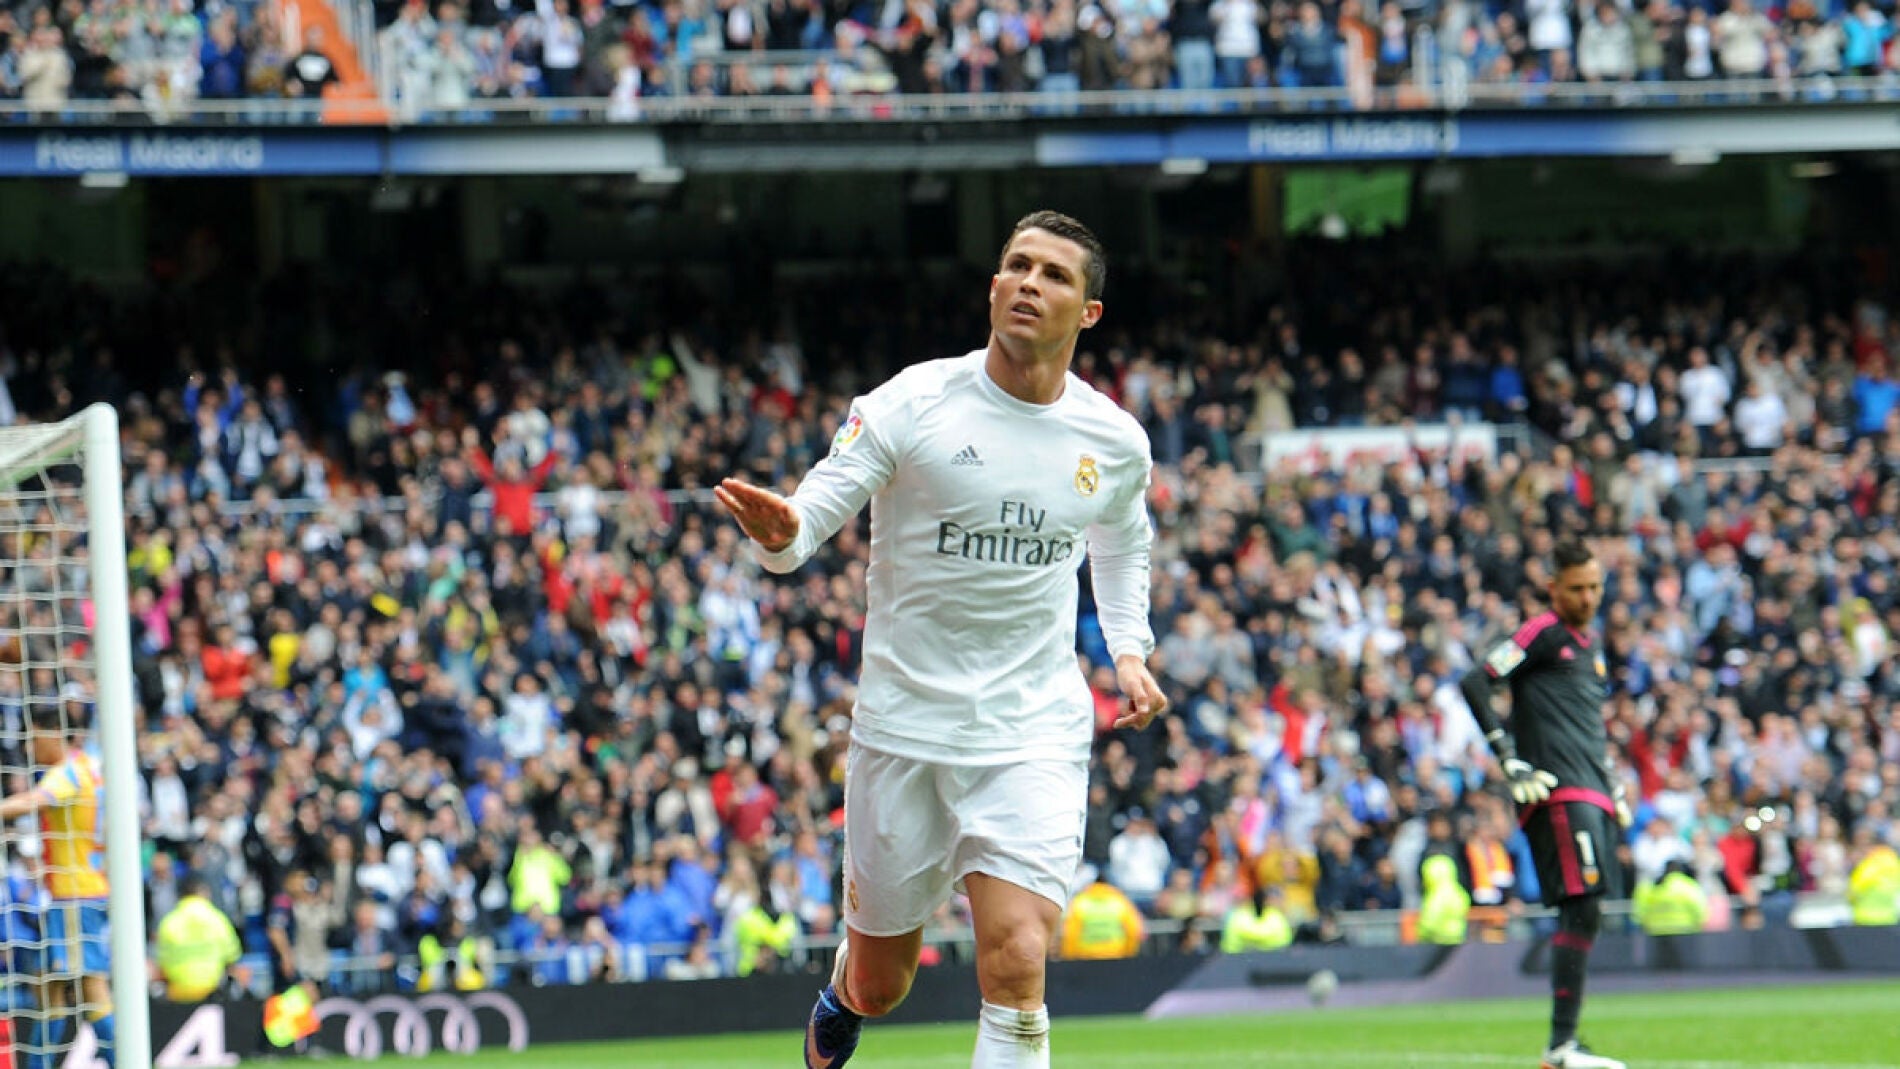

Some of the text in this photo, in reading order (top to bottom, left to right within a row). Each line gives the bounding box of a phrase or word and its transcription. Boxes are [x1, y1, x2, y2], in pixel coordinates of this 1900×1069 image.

[37, 132, 264, 169] Real Madrid
[1249, 119, 1326, 153] Real
[1000, 500, 1046, 532] Fly
[1575, 830, 1595, 866] 1
